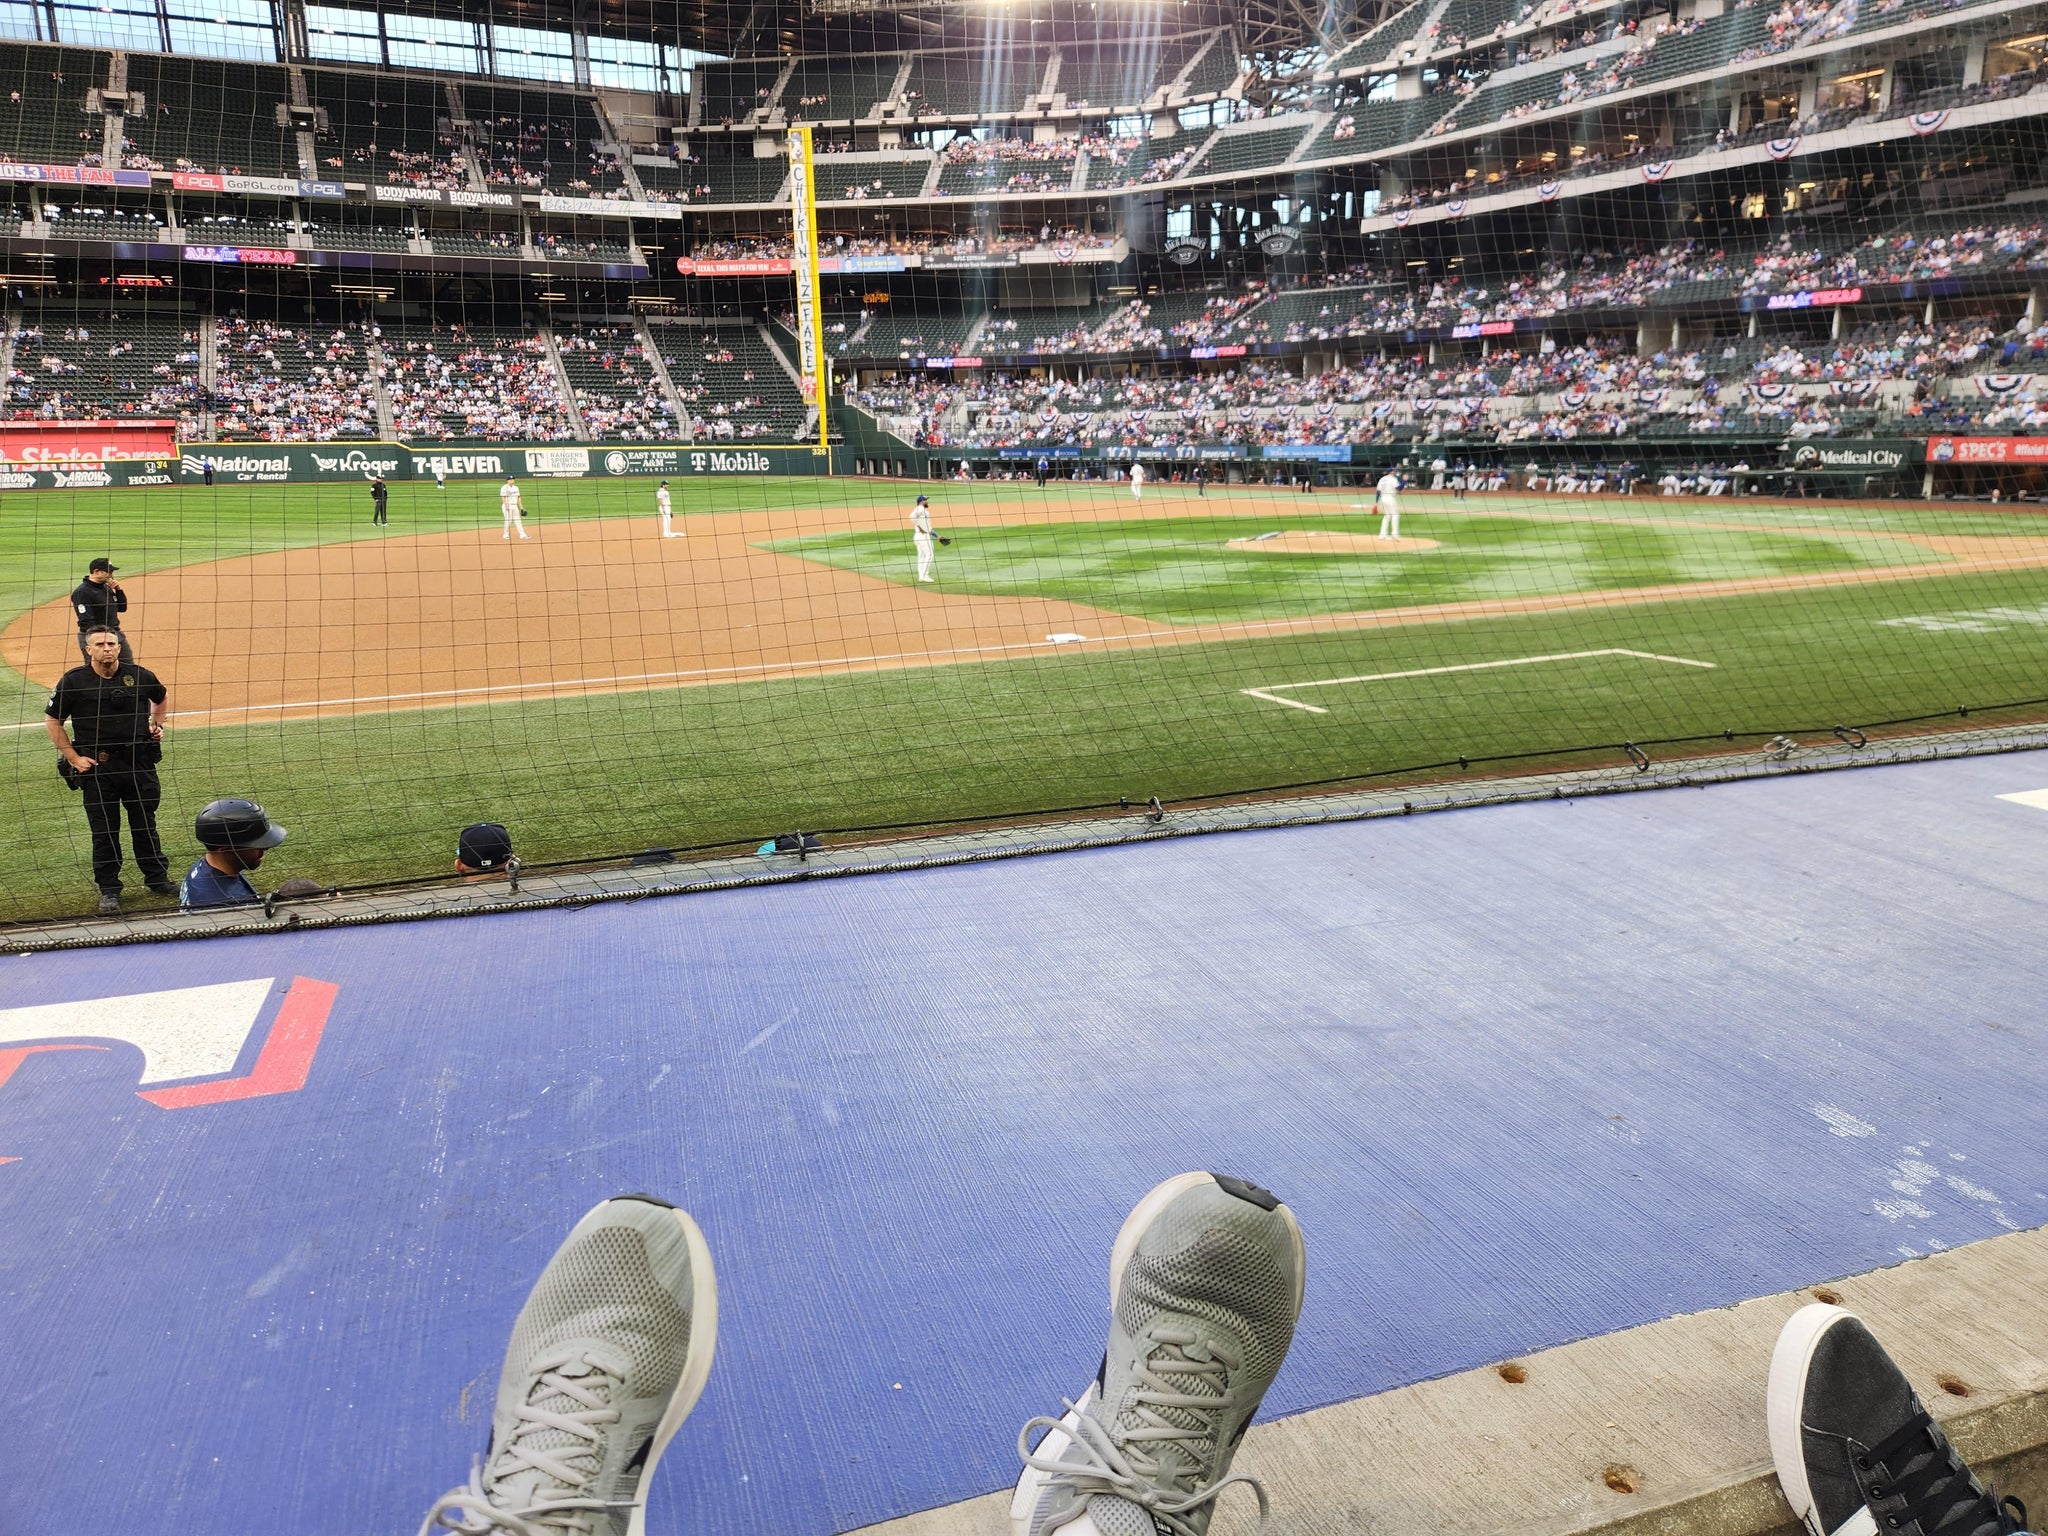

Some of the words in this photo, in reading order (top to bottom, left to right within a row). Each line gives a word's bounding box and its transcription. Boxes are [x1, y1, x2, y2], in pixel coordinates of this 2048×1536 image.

[43, 167, 77, 181] THE
[80, 169, 115, 183] FAN
[188, 177, 219, 188] PGL
[227, 180, 294, 191] GoPGL.com
[313, 186, 342, 196] PGL
[375, 186, 441, 200] BODYARMOR
[449, 191, 513, 205] BODYARMOR
[1254, 228, 1271, 244] JACK
[185, 247, 220, 261] ALL
[238, 249, 296, 264] TEXAS
[1959, 441, 2007, 458] SPEC'S
[340, 451, 398, 480] Kroger
[643, 459, 664, 467] A&M
[710, 453, 769, 471] Mobile
[1820, 450, 1872, 464] Medical
[1873, 450, 1903, 468] City
[68, 472, 103, 481] ARROW
[128, 475, 174, 485] HONDA
